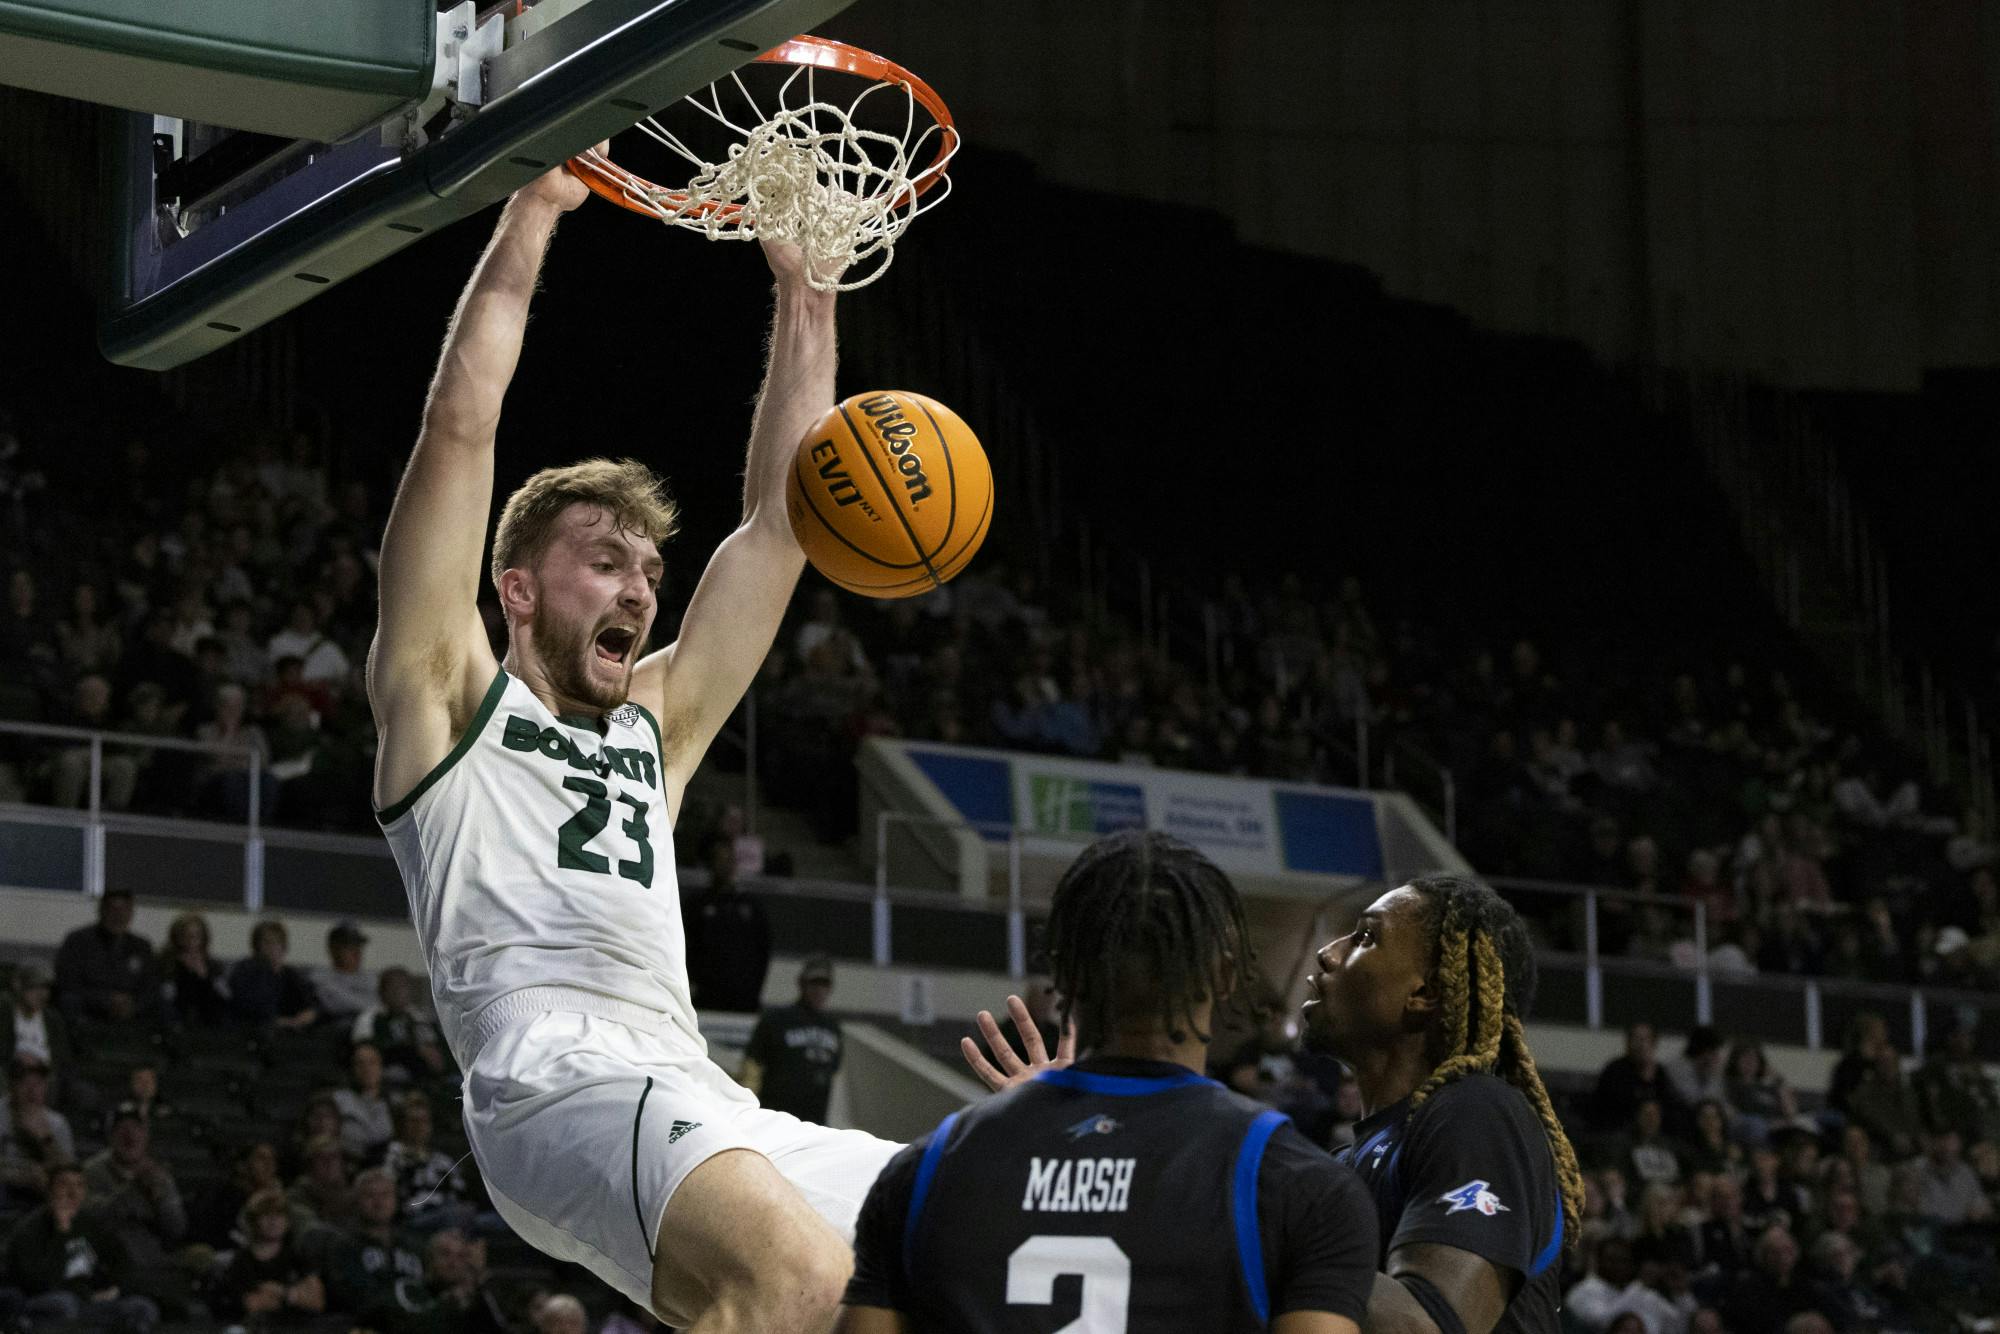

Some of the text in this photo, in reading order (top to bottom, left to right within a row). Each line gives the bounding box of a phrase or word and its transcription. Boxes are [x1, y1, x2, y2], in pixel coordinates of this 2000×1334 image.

[811, 439, 882, 523] EVO NXT
[858, 394, 933, 505] Wilson
[558, 775, 655, 890] 23
[668, 1122, 703, 1144] adidas
[1021, 1155, 1137, 1212] MARSH
